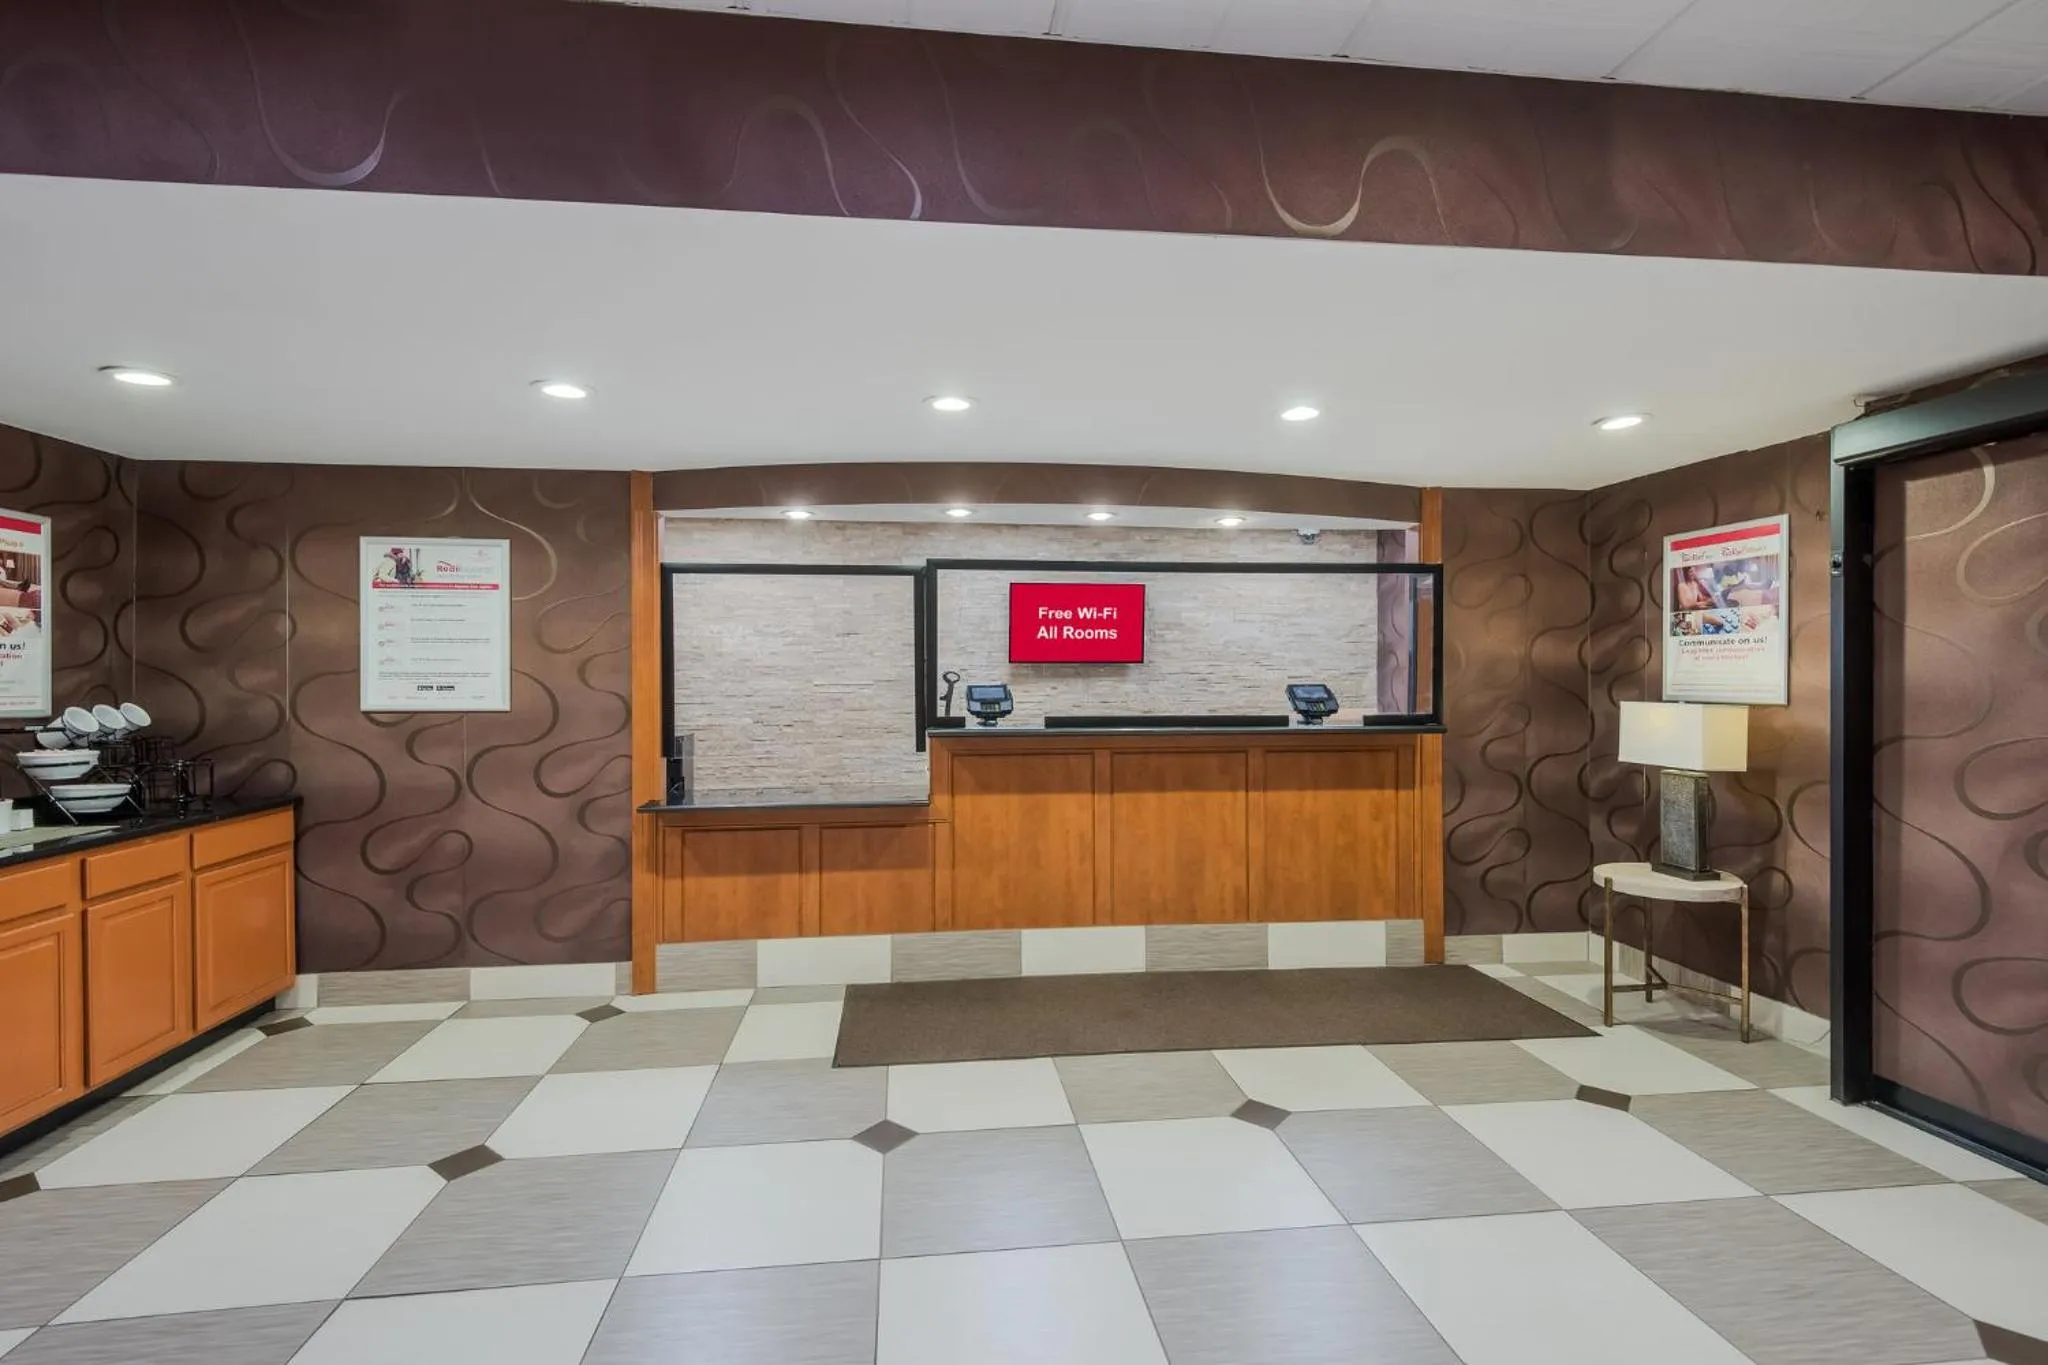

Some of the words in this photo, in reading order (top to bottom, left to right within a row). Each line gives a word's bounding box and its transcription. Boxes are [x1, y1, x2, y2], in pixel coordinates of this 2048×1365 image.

[1038, 607, 1073, 619] Free
[1077, 607, 1118, 619] Wi-Fi
[1036, 625, 1058, 639] All
[1062, 625, 1118, 640] Rooms
[10, 641, 26, 651] us!
[1679, 638, 1737, 647] Communicate
